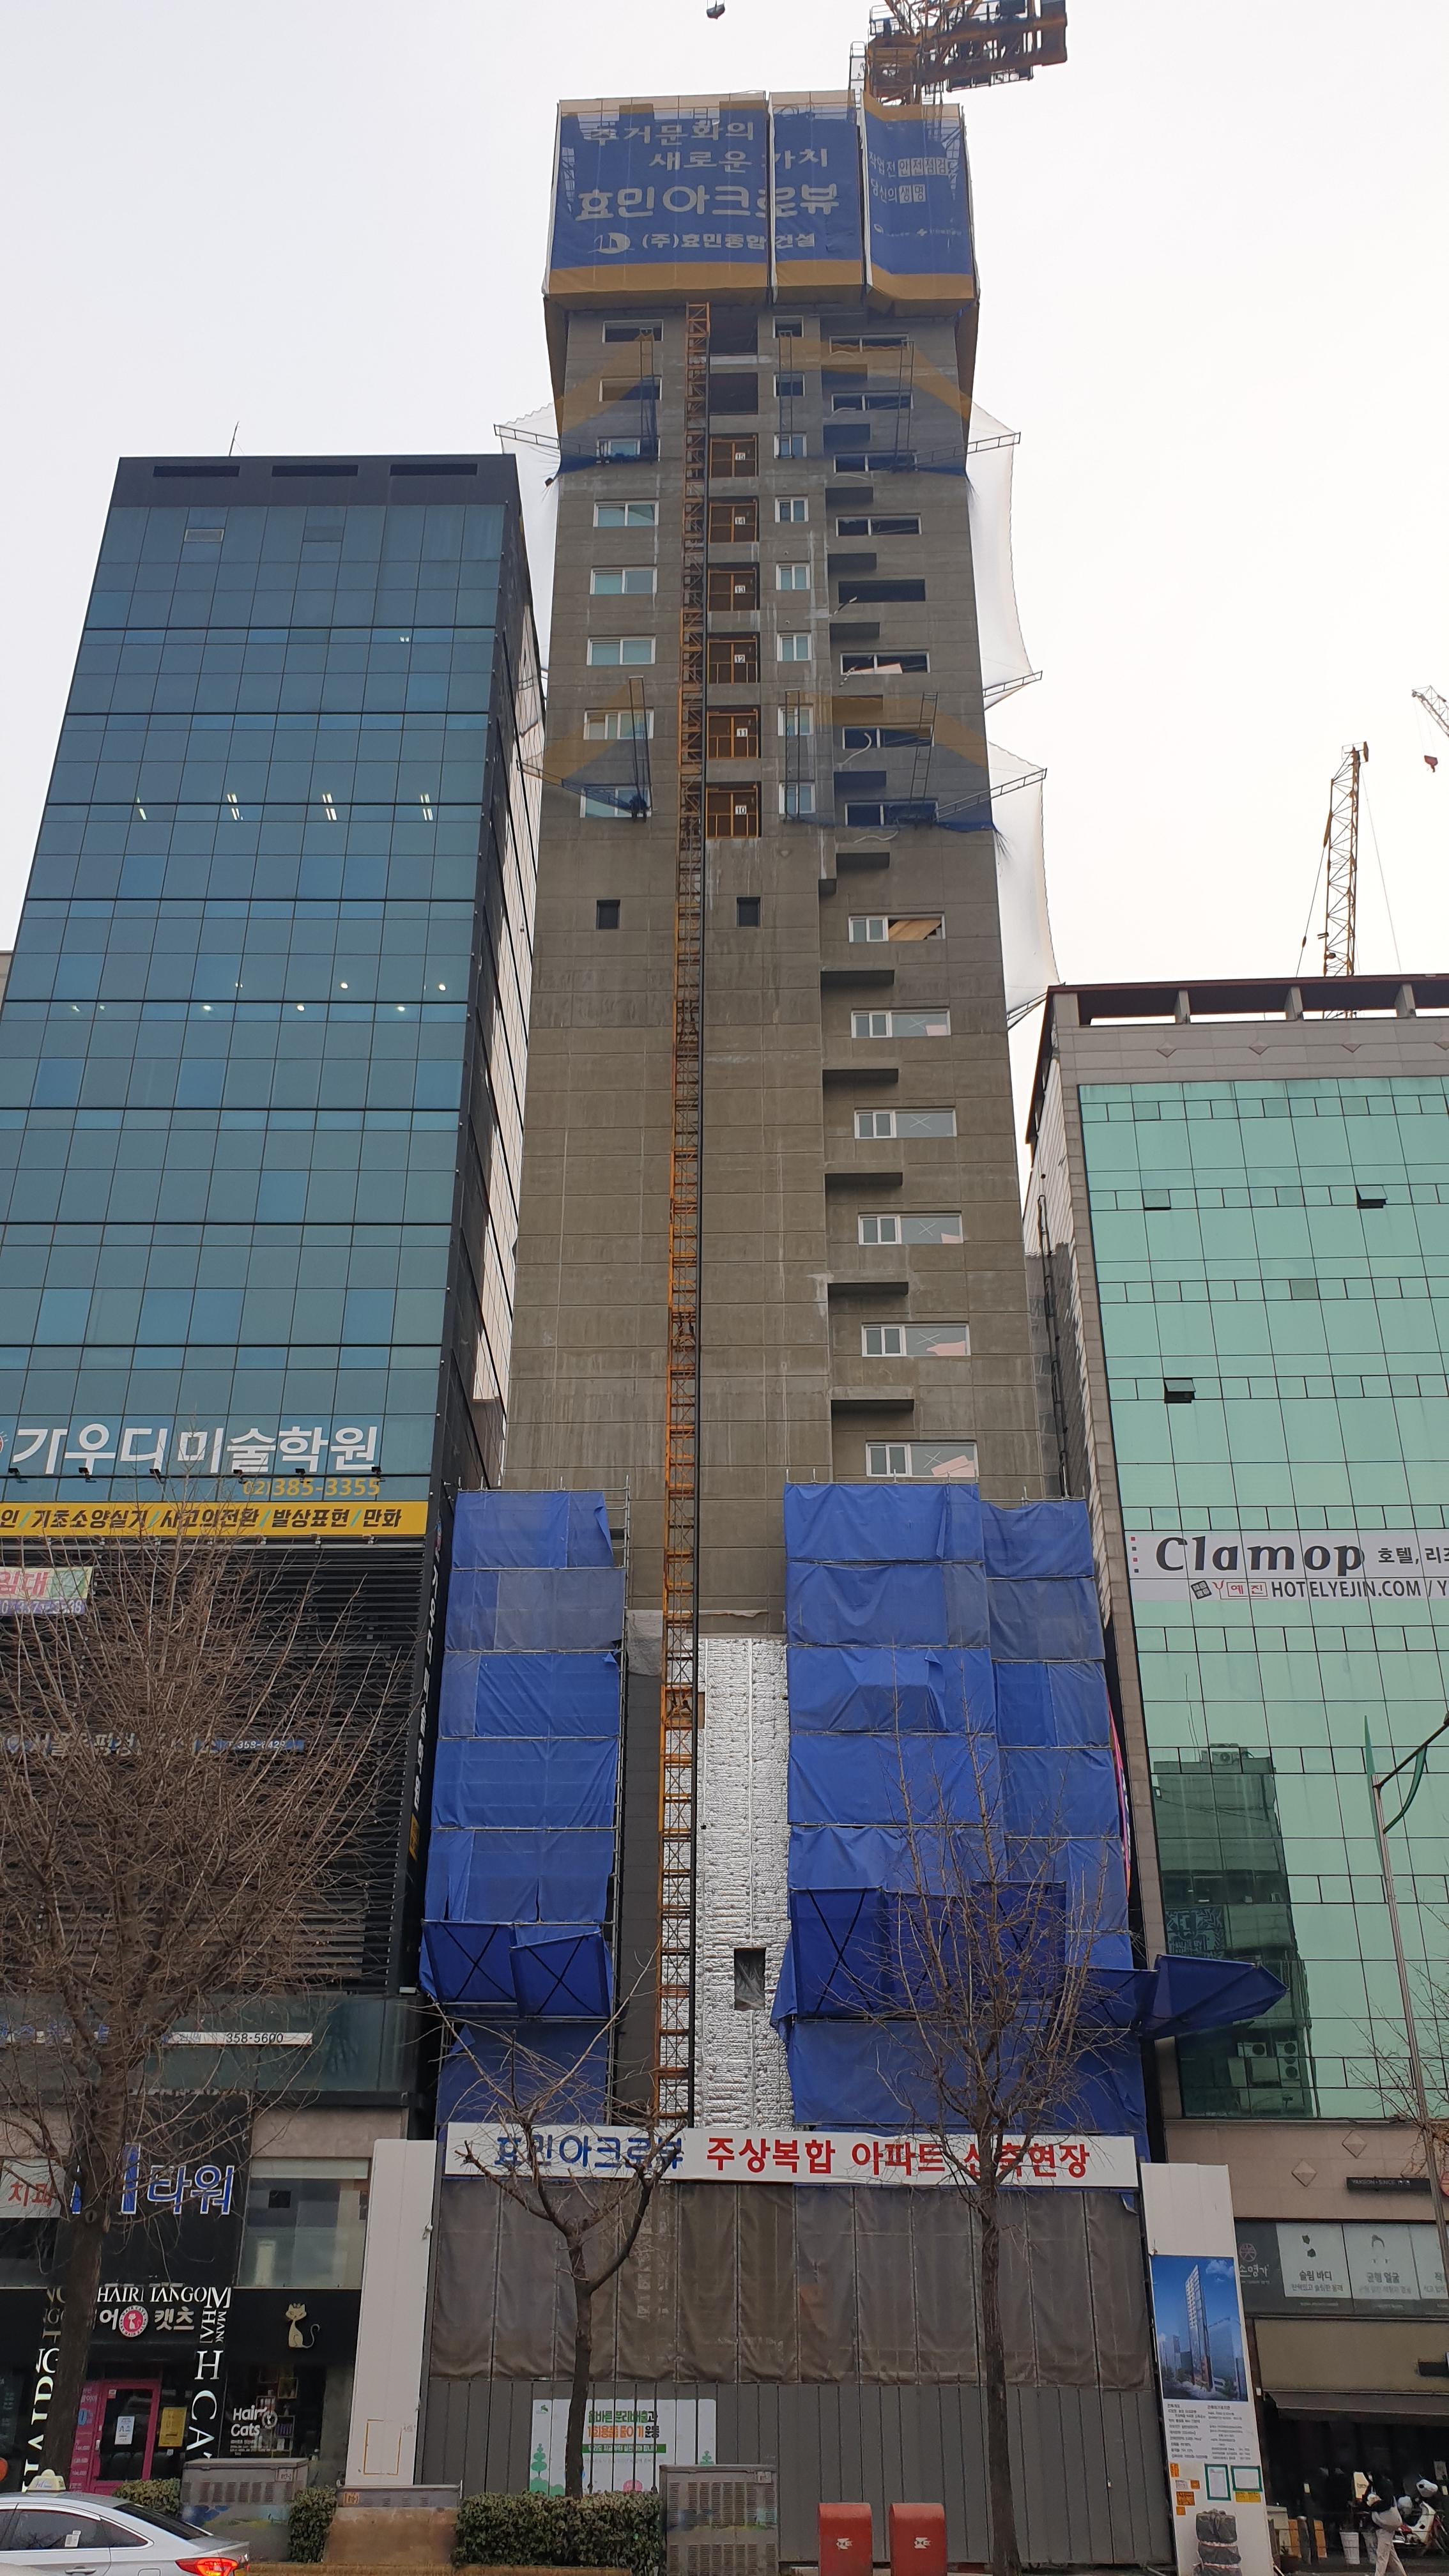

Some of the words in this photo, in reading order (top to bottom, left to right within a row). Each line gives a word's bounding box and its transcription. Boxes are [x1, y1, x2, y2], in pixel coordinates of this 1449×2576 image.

[648, 150, 753, 174] 새로운
[242, 1477, 381, 1497] 02)385-3355
[272, 1508, 350, 1528] 발상표현
[363, 1508, 402, 1528] 만화
[1156, 1535, 1365, 1577] Clamop
[1271, 1580, 1422, 1598] HOTELYEJIN.COM
[226, 2032, 284, 2044] 358-5600
[706, 2137, 836, 2174] 주상복합
[851, 2140, 946, 2176] 아파트
[146, 2165, 235, 2215] 타워
[233, 2404, 267, 2421] Hair
[231, 2423, 260, 2437] Cats
